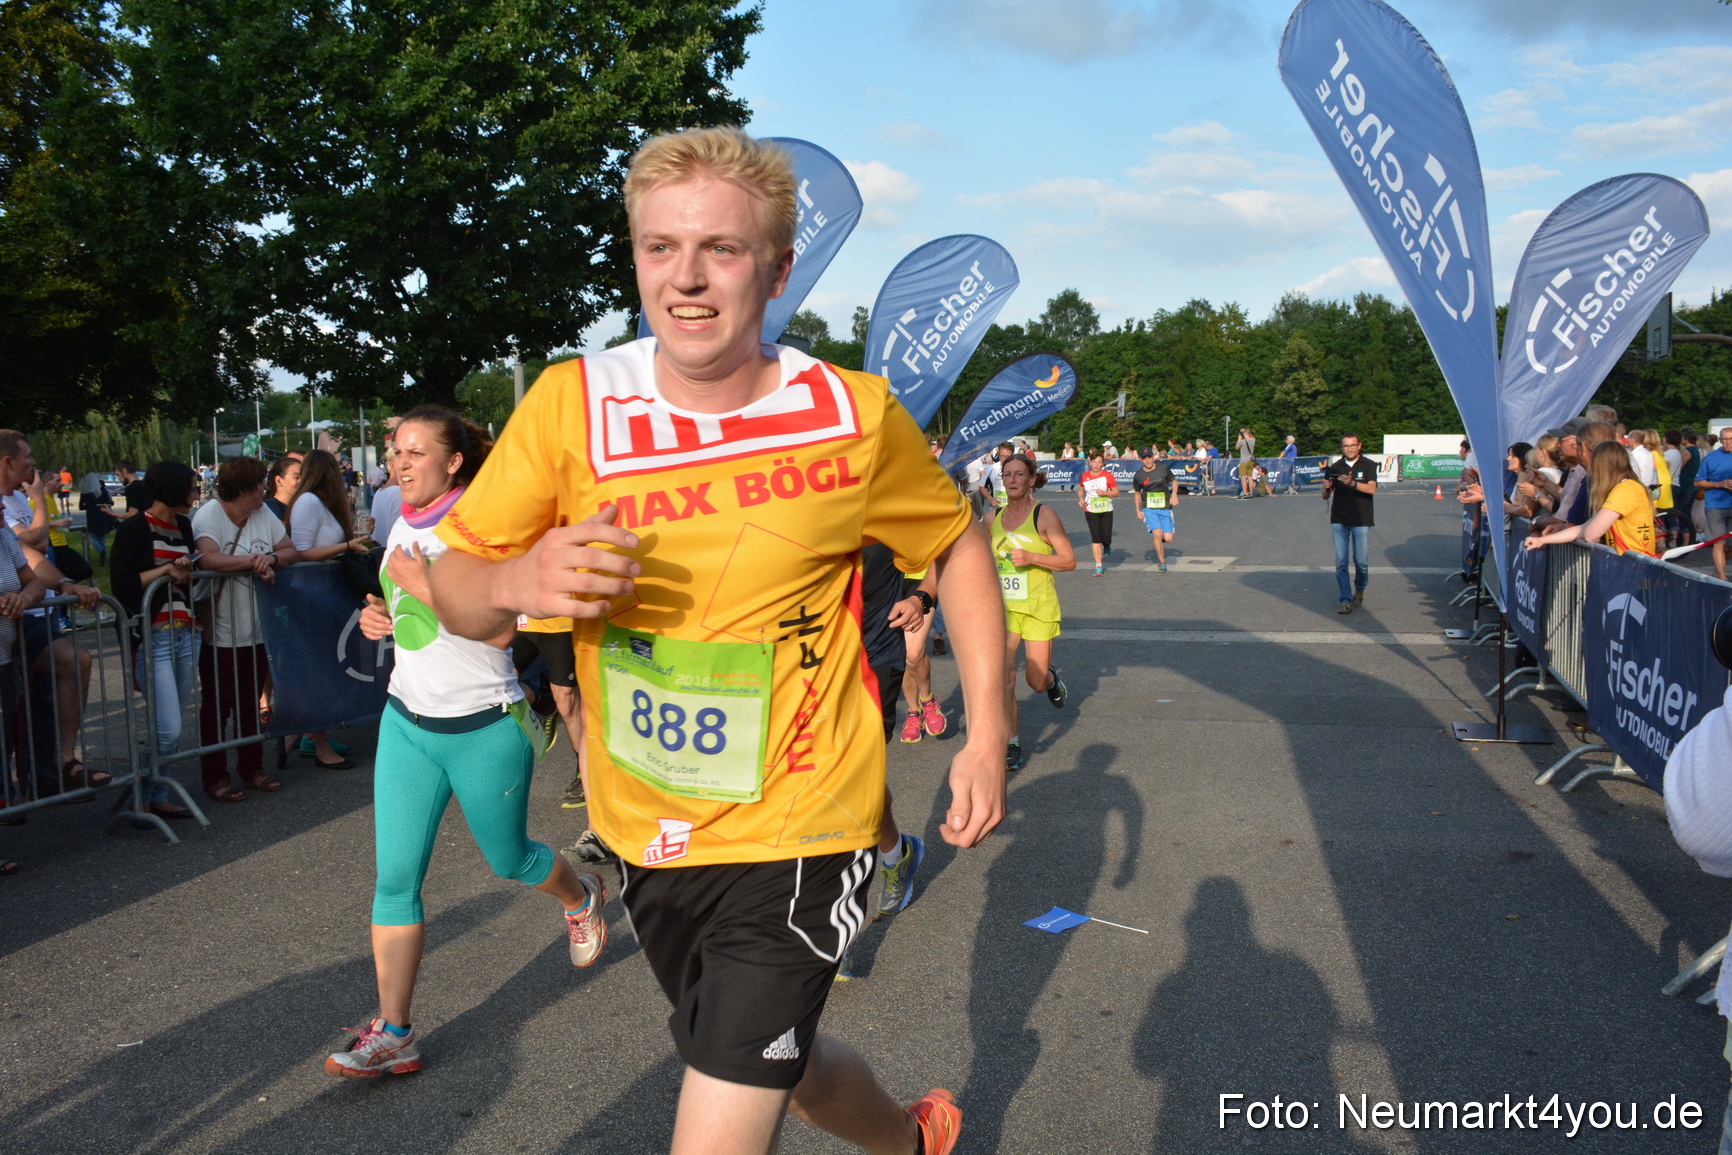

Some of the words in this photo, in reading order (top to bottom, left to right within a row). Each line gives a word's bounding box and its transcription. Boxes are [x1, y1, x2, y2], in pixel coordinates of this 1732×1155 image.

[1552, 205, 1663, 351] Fischer
[1589, 231, 1676, 349] AUTOMOBILE
[901, 260, 985, 376] Fischer
[931, 281, 996, 373] AUTOMOBILE
[960, 389, 1044, 442] Frischmann
[1013, 404, 1034, 420] Druck
[1047, 383, 1072, 404] Medien
[597, 482, 719, 530] MAX
[734, 455, 861, 509] BÖGL
[1046, 471, 1073, 479] ischer
[675, 673, 712, 688] 2016
[1610, 639, 1697, 732] Fischer
[631, 688, 727, 756] 888
[661, 759, 700, 775] Gruber
[762, 1046, 800, 1060] adidas
